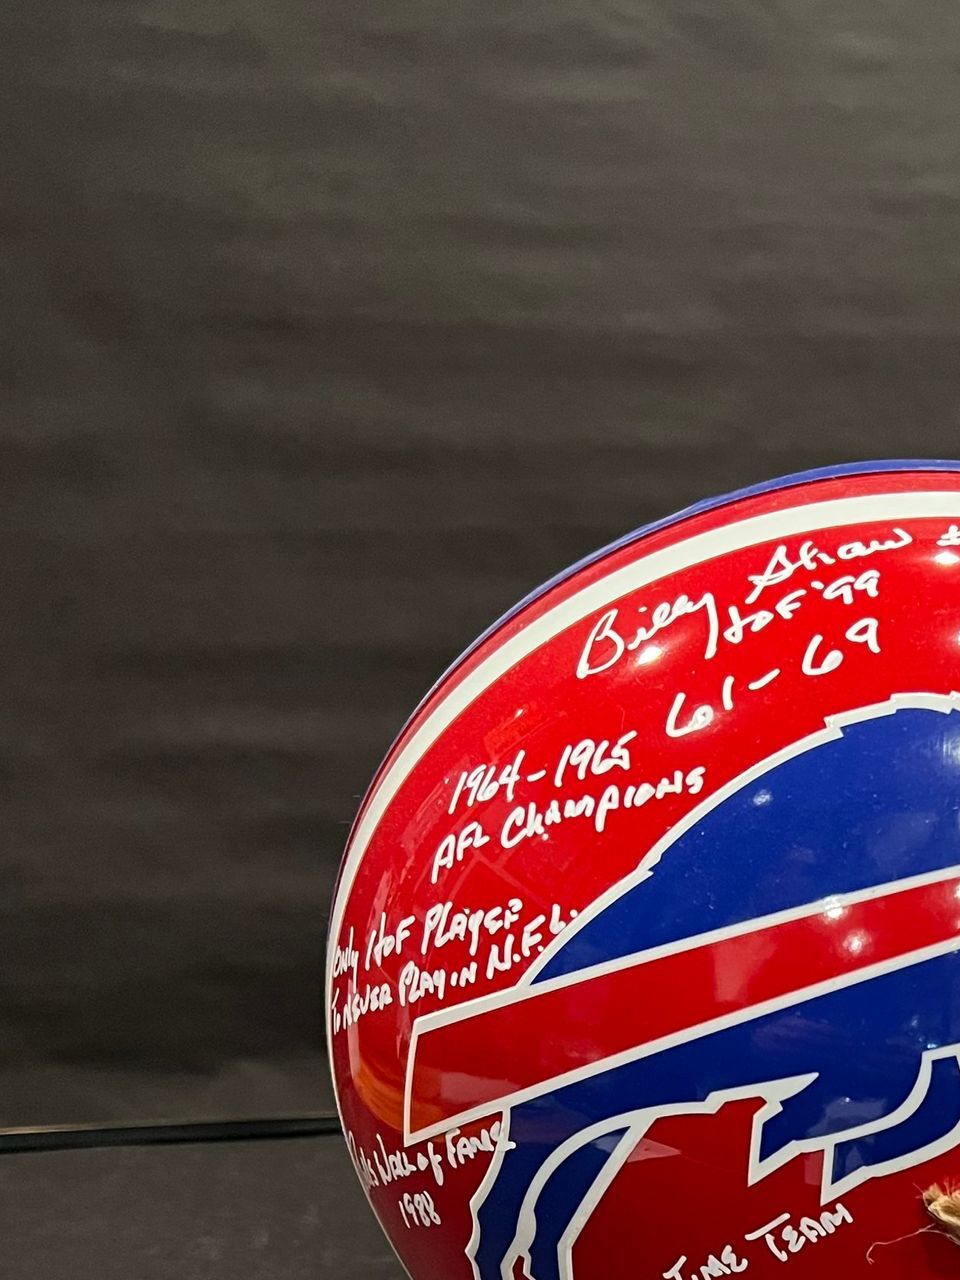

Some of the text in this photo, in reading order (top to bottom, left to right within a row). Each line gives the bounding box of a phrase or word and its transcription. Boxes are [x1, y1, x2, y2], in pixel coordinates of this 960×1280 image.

[576, 591, 718, 679] Billy
[745, 528, 913, 604] Shaw
[810, 569, 881, 604] '99
[430, 822, 490, 884] AFL
[398, 960, 446, 1007] PLAY
[398, 1190, 442, 1229] 1988
[744, 1203, 853, 1262] TEAM
